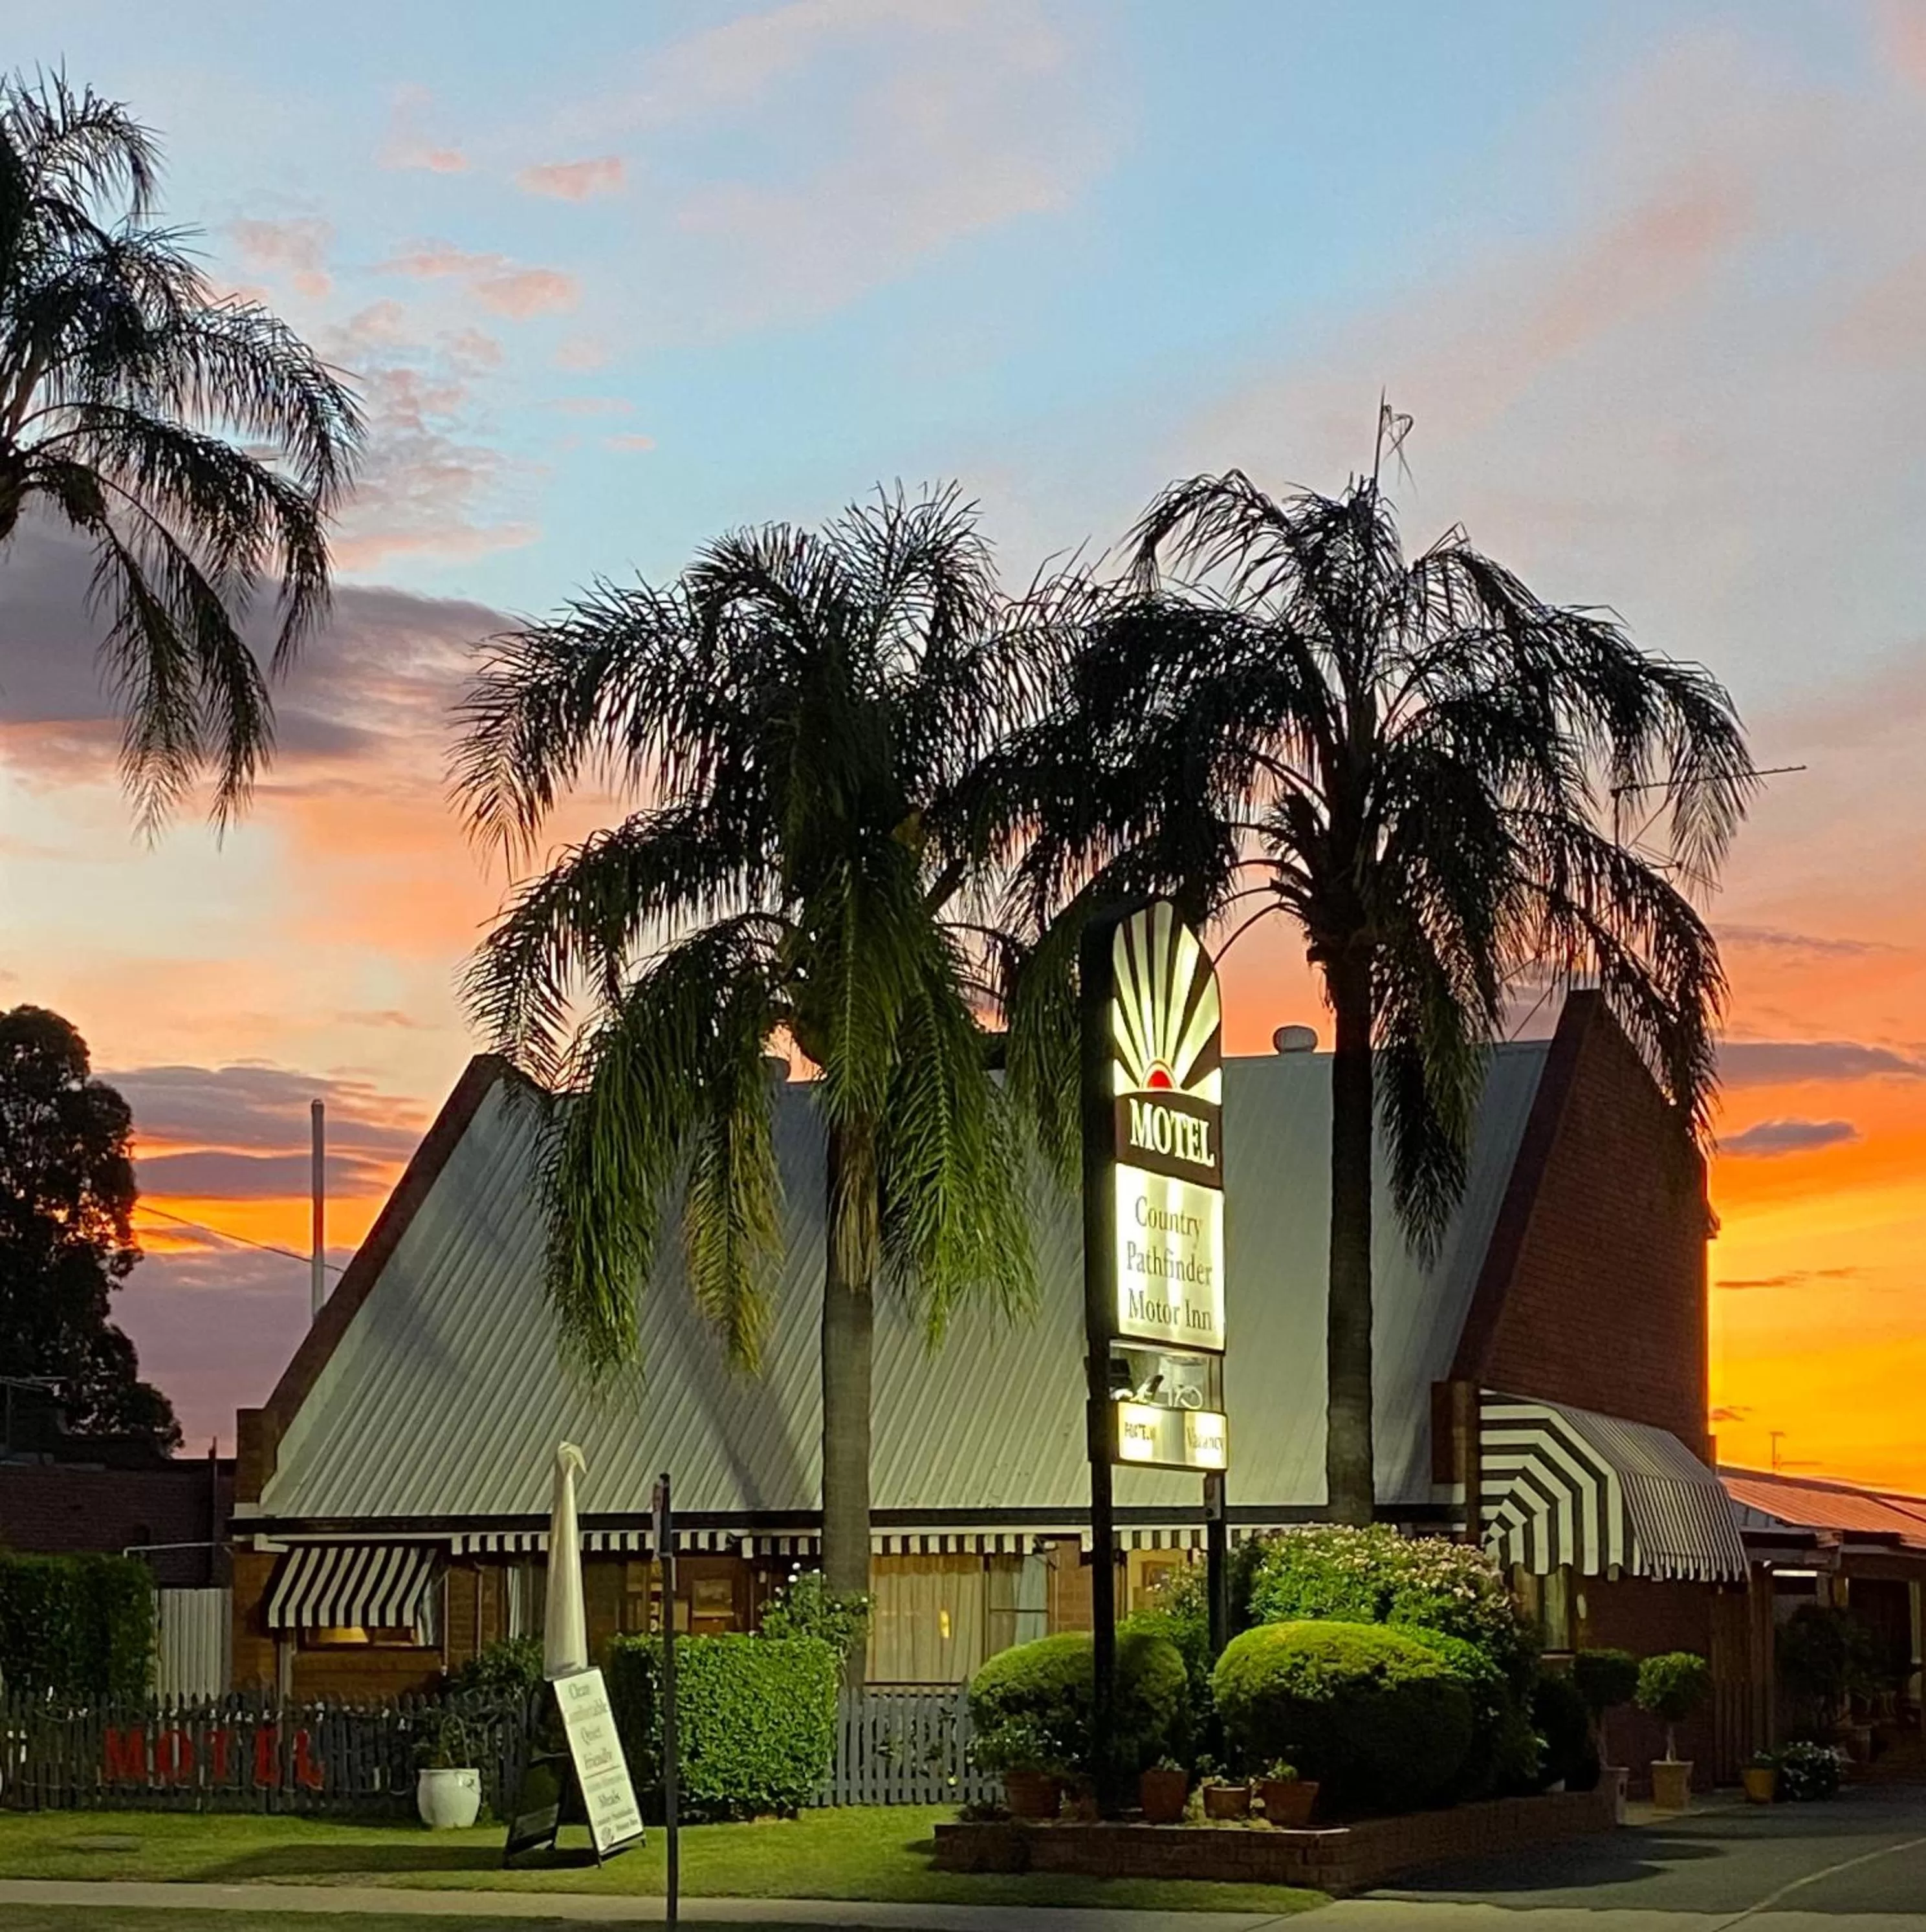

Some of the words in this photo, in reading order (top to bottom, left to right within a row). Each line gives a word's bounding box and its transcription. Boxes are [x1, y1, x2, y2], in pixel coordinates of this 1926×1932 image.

[1130, 1098, 1215, 1167] MOTEL
[1135, 1195, 1203, 1250] Country
[1126, 1240, 1212, 1286] Pathfinder
[1128, 1288, 1180, 1325] Motor
[1185, 1299, 1212, 1330] Inn
[103, 1723, 324, 1790] MOTEL
